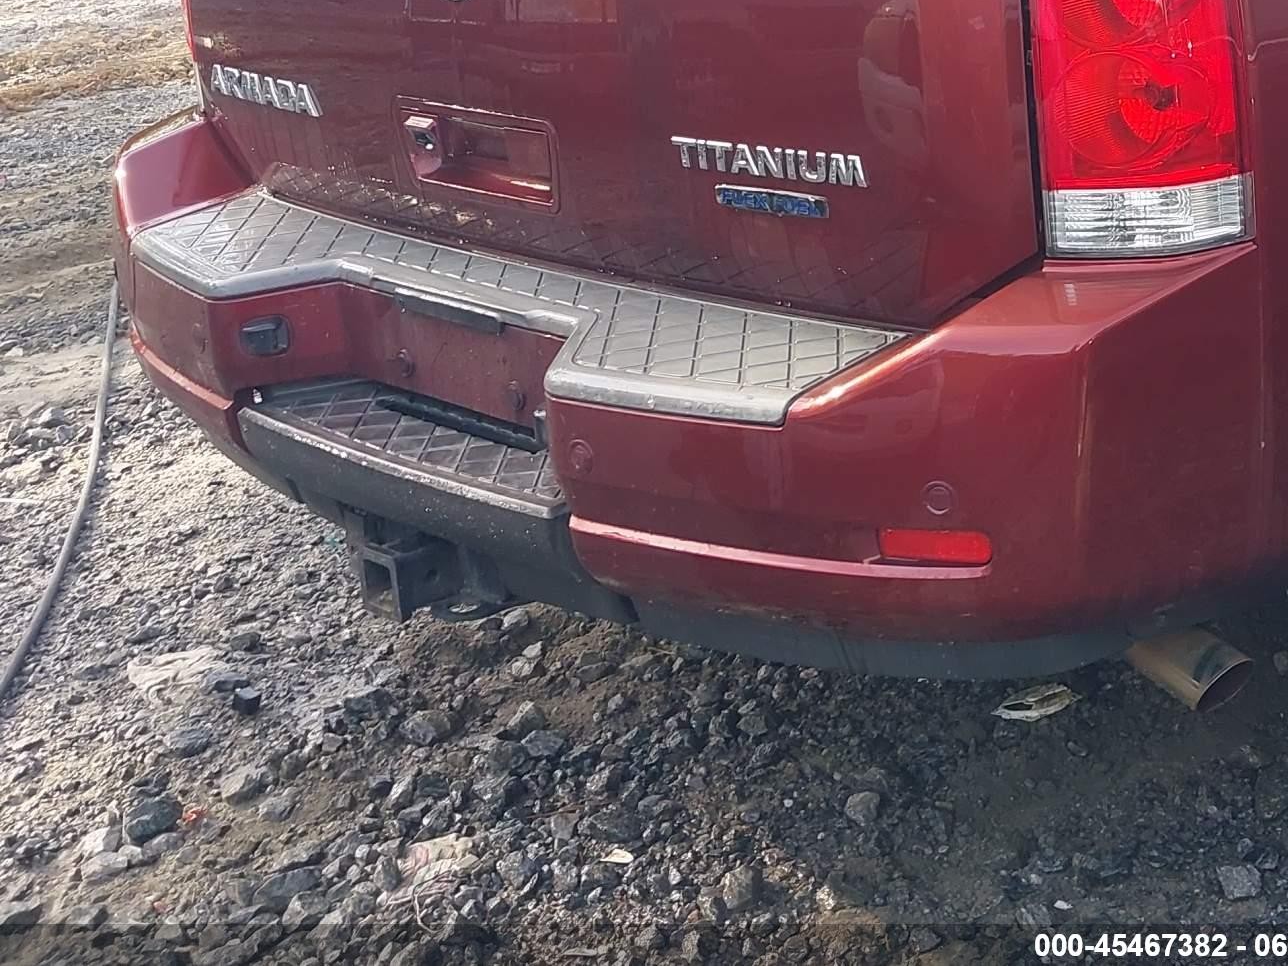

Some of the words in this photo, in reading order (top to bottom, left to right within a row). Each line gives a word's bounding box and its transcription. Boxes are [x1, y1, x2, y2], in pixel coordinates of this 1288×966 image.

[210, 63, 321, 117] ARMADA
[670, 135, 868, 188] TITANIUM
[720, 188, 769, 211] FLEX
[773, 195, 822, 218] FUEL
